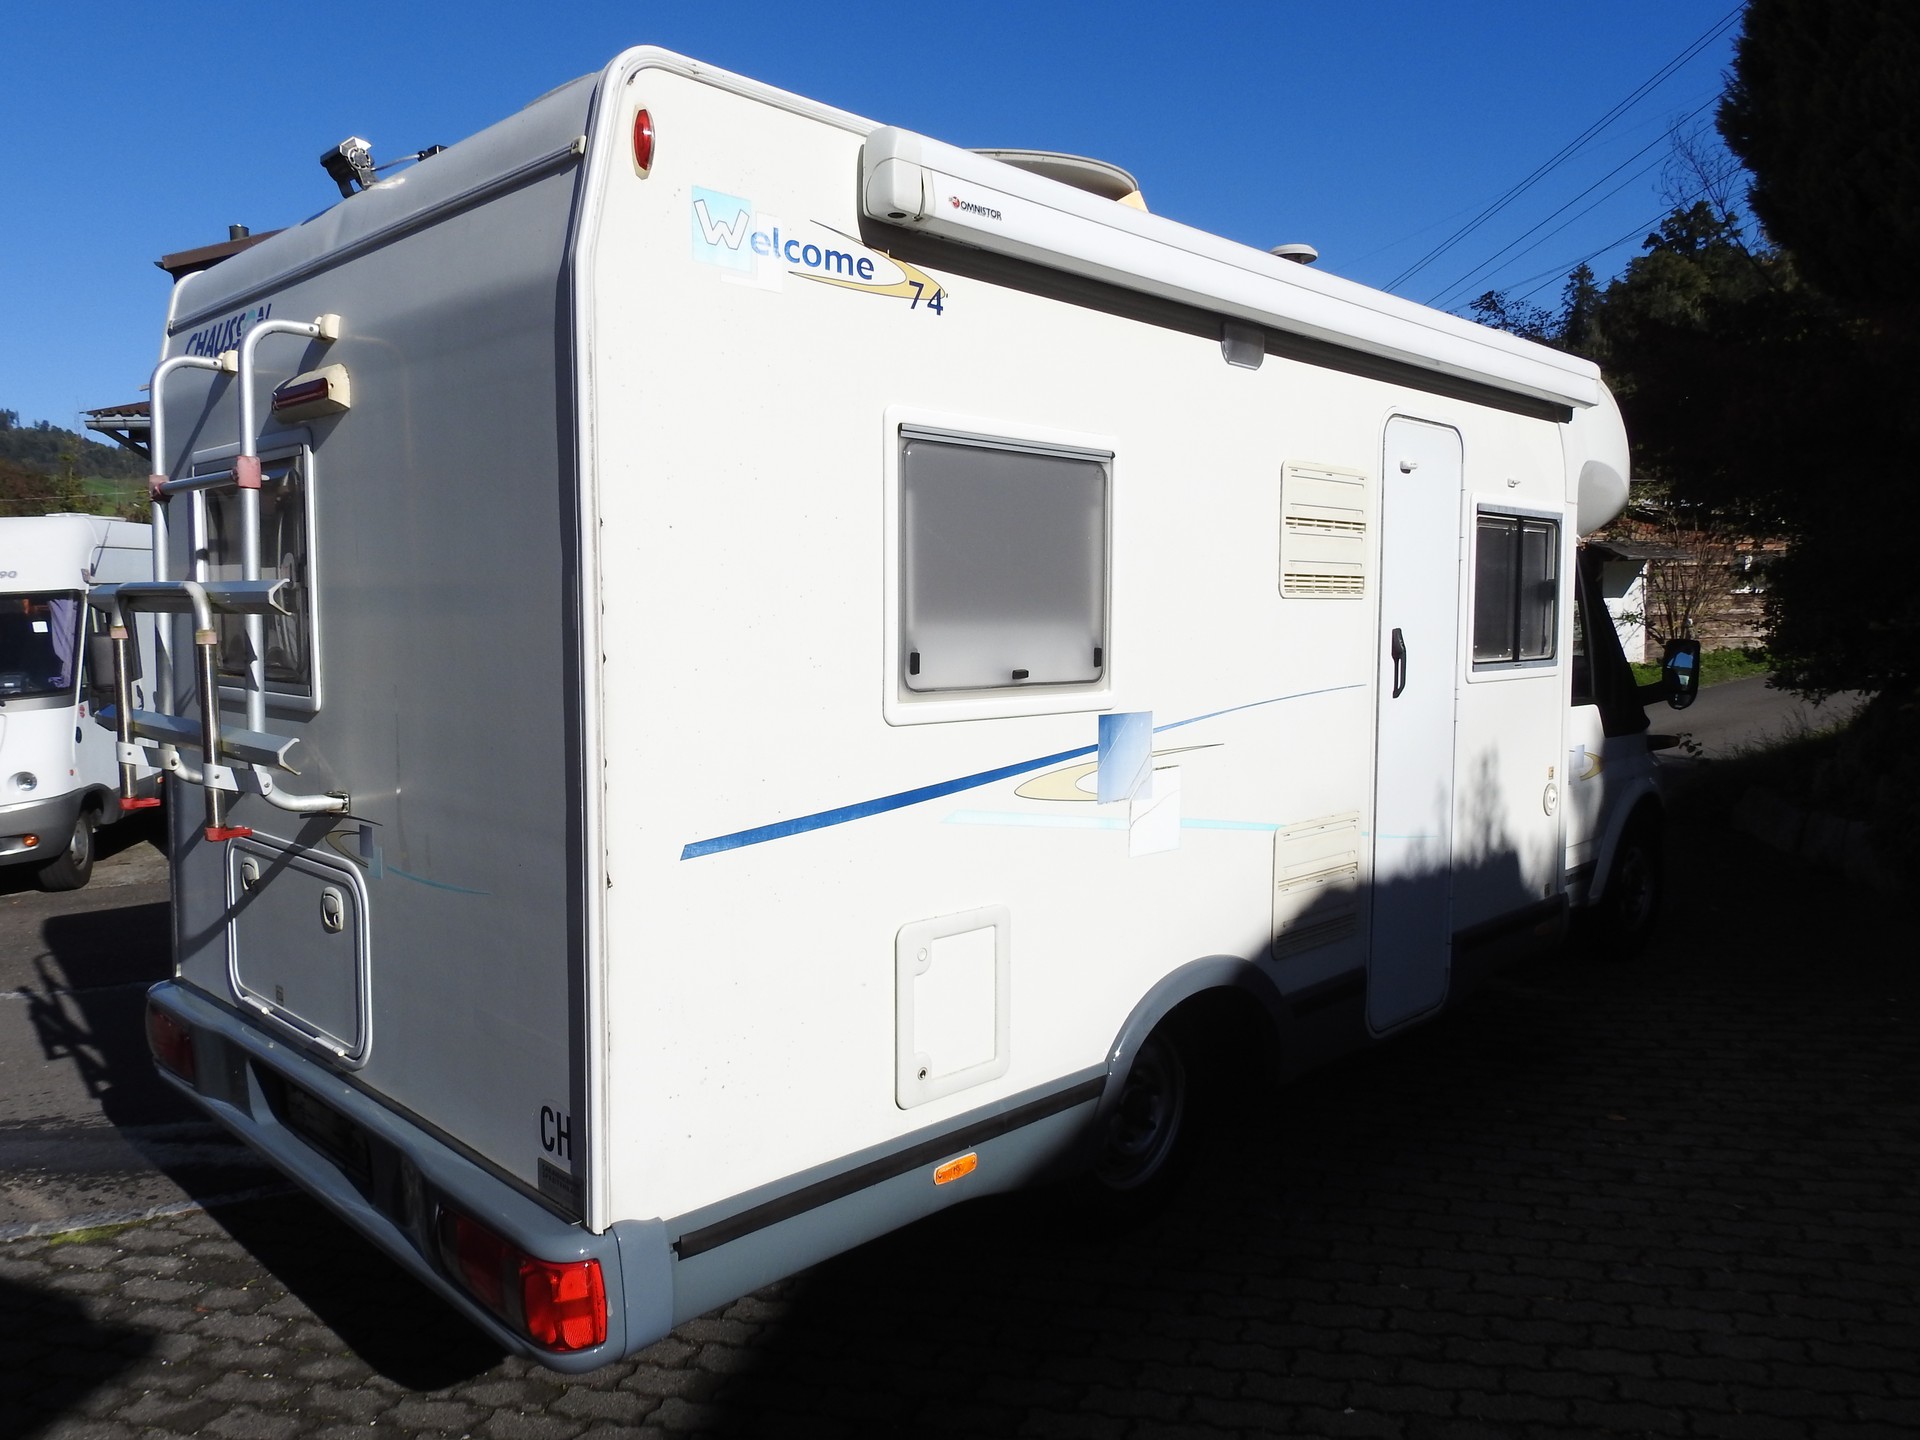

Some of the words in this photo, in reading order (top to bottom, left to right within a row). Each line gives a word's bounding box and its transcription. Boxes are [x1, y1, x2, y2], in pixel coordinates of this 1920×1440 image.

[960, 200, 1003, 221] OMNISTOR
[694, 199, 875, 280] Welcome
[908, 281, 944, 316] 74
[540, 1105, 572, 1162] CH
